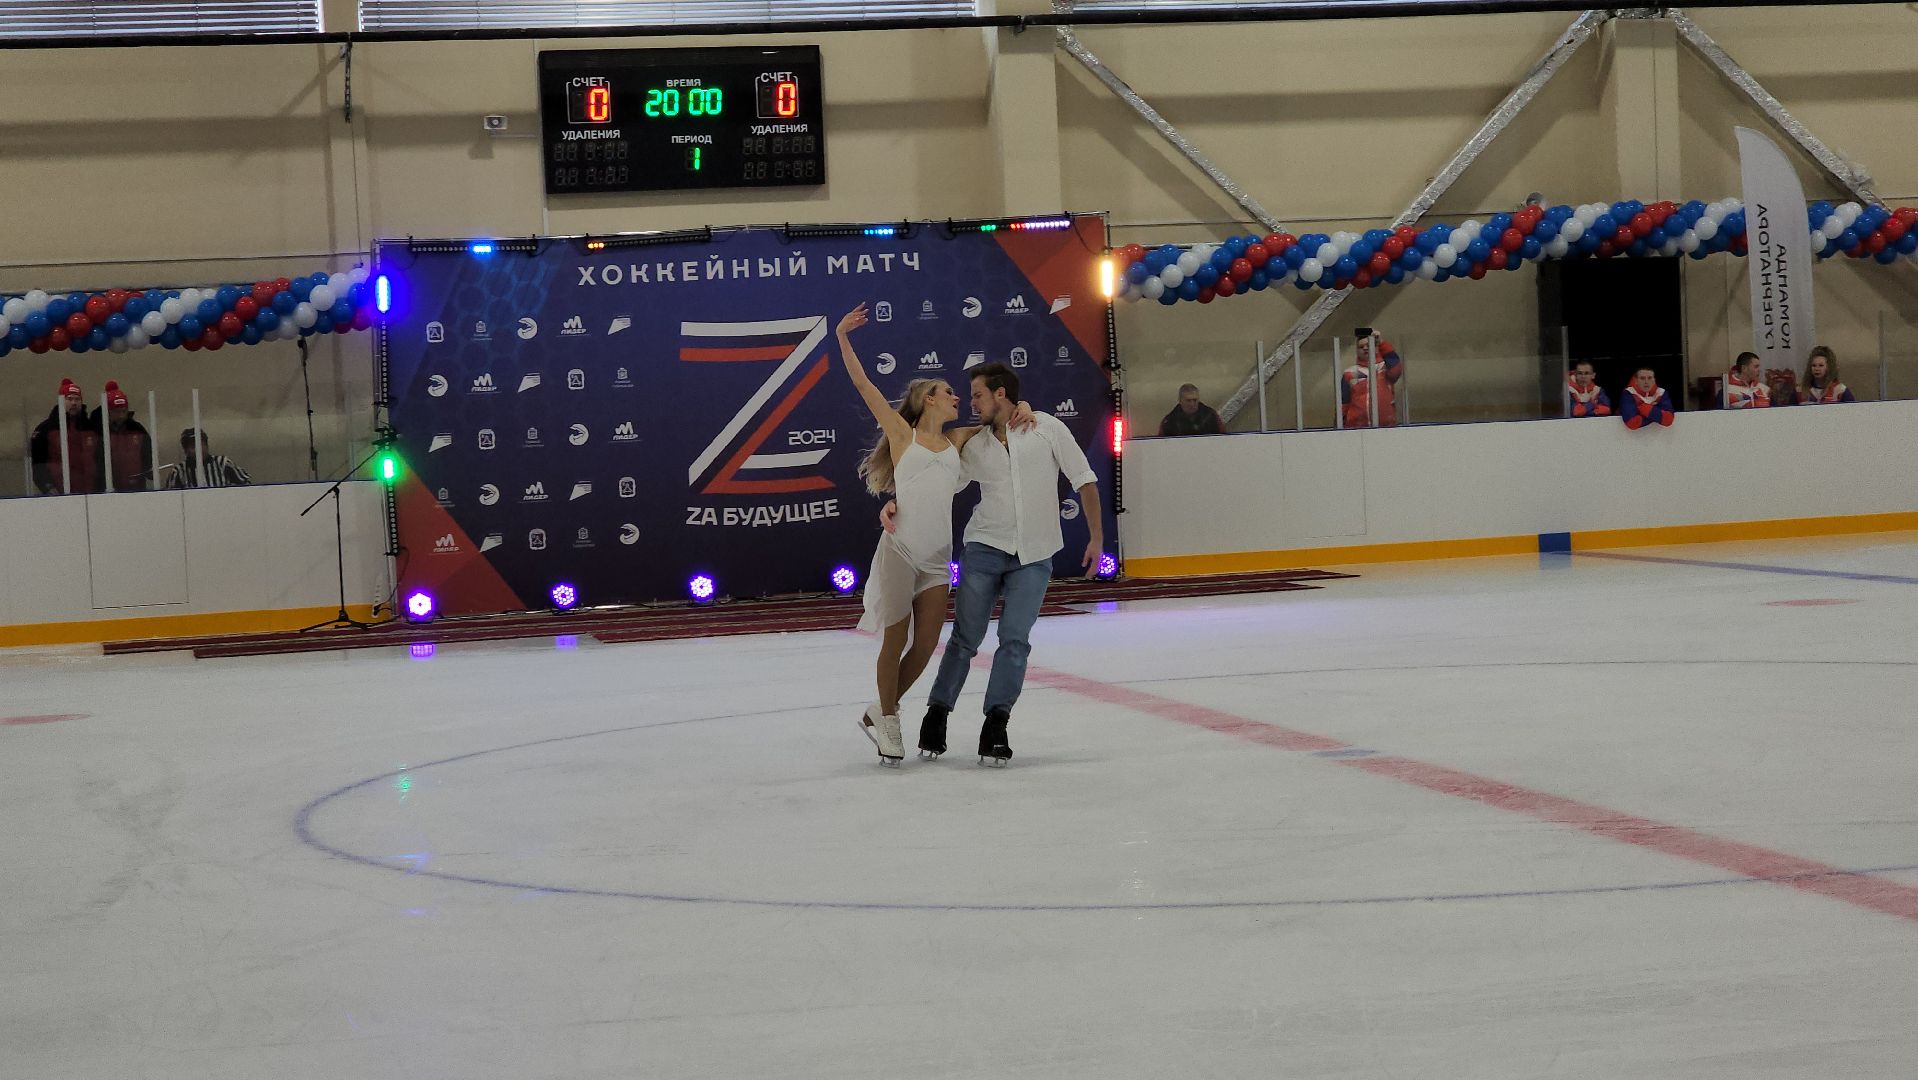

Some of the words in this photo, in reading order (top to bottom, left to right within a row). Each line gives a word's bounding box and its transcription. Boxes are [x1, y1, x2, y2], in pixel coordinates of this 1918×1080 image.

[572, 76, 605, 87] СЧЕТ
[666, 78, 701, 88] ВРЕМЯ
[760, 71, 793, 83] СЧЕТ
[589, 88, 608, 121] 0
[777, 83, 796, 116] 0
[561, 129, 621, 140] УДАЛЕНИЯ
[750, 123, 808, 135] УДАЛЕНИЯ
[671, 134, 713, 145] ПЕРИОД
[693, 147, 701, 170] 1
[577, 251, 808, 287] ХОККЕЙНЫЙ
[827, 252, 921, 275] МАТЧ
[788, 429, 836, 446] 2024
[685, 506, 719, 526] ZA
[722, 498, 841, 528] БУДУЩЕЕ
